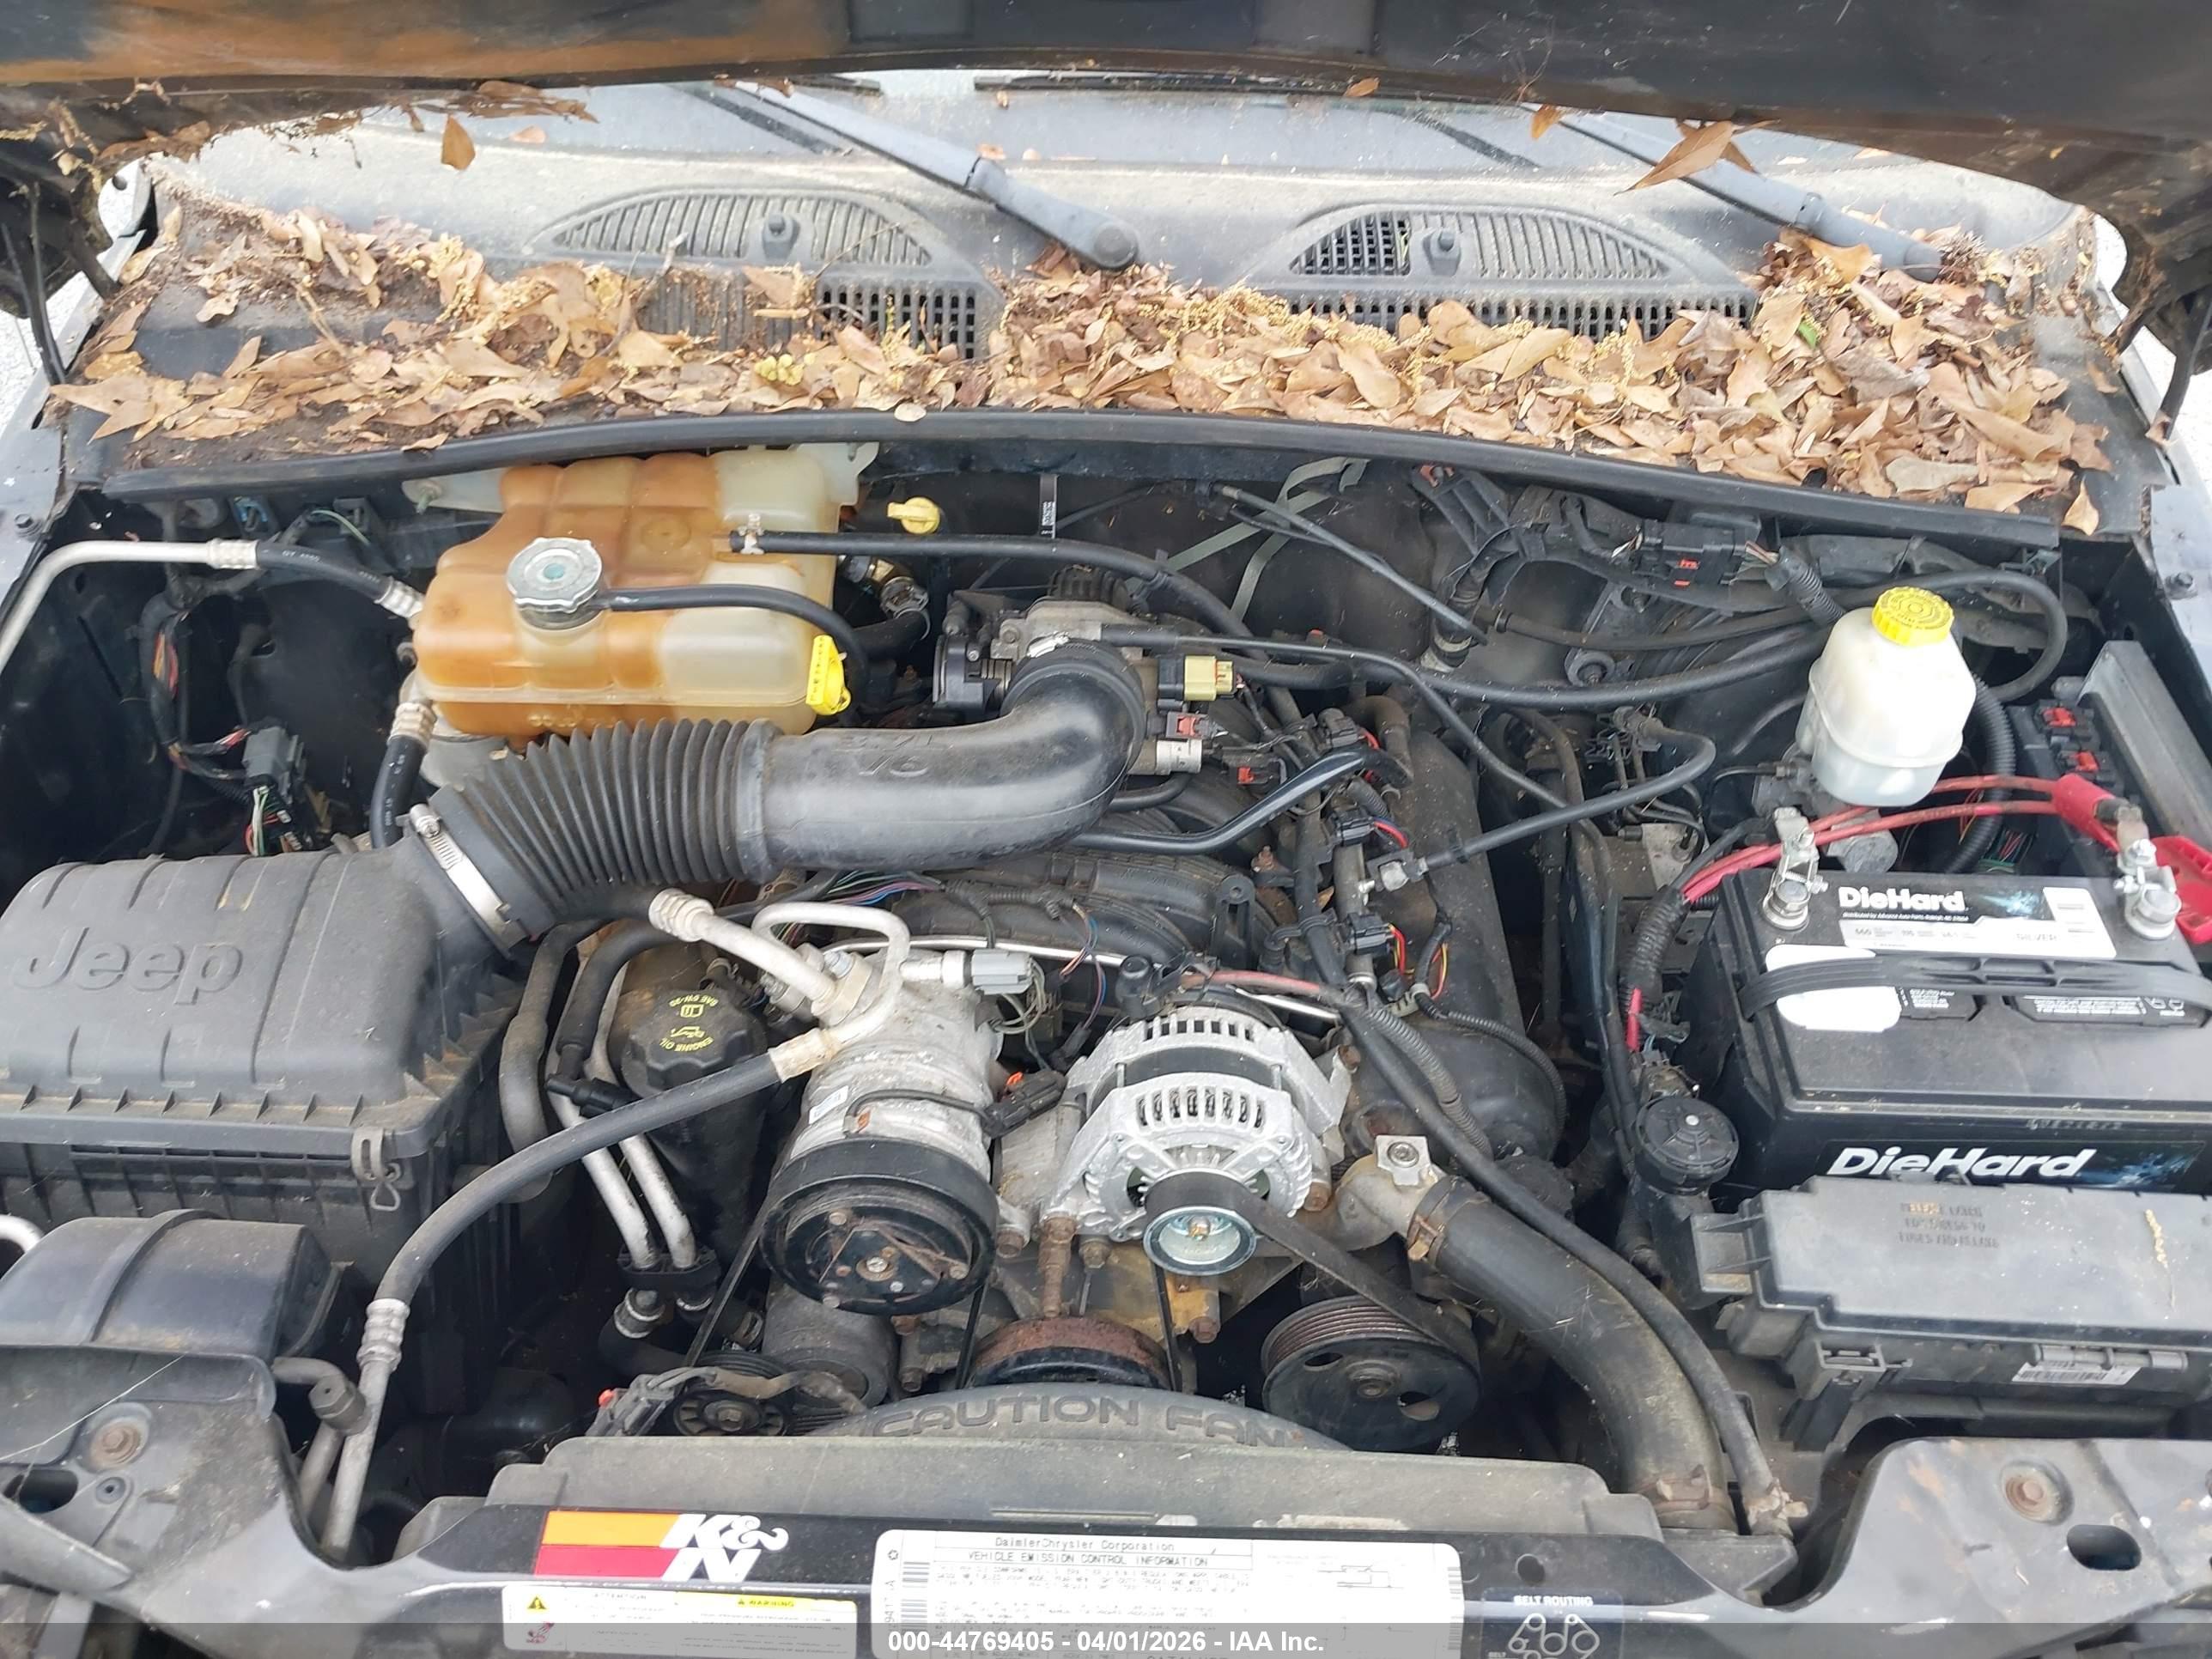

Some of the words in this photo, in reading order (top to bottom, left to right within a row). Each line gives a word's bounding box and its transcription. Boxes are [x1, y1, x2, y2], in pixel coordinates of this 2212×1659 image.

[1838, 885, 1966, 912] DieHard
[12, 927, 243, 1006] Jeep
[659, 1037, 675, 1049] OIL
[1827, 1146, 2098, 1177] DieHard
[872, 1394, 1139, 1437] CAUTION
[1164, 1405, 1289, 1447] FAN
[659, 1513, 789, 1583] K&N
[995, 1536, 1093, 1552] DaimlerChrysler
[1101, 1540, 1175, 1553] Corporation
[968, 1551, 1014, 1561] VEHICLE
[1020, 1552, 1074, 1563] EMISSION
[1080, 1553, 1127, 1565] CONTROL
[1136, 1556, 1208, 1567] INFORMATION
[1514, 1595, 1543, 1607] BELT
[1543, 1595, 1594, 1607] ROUTING
